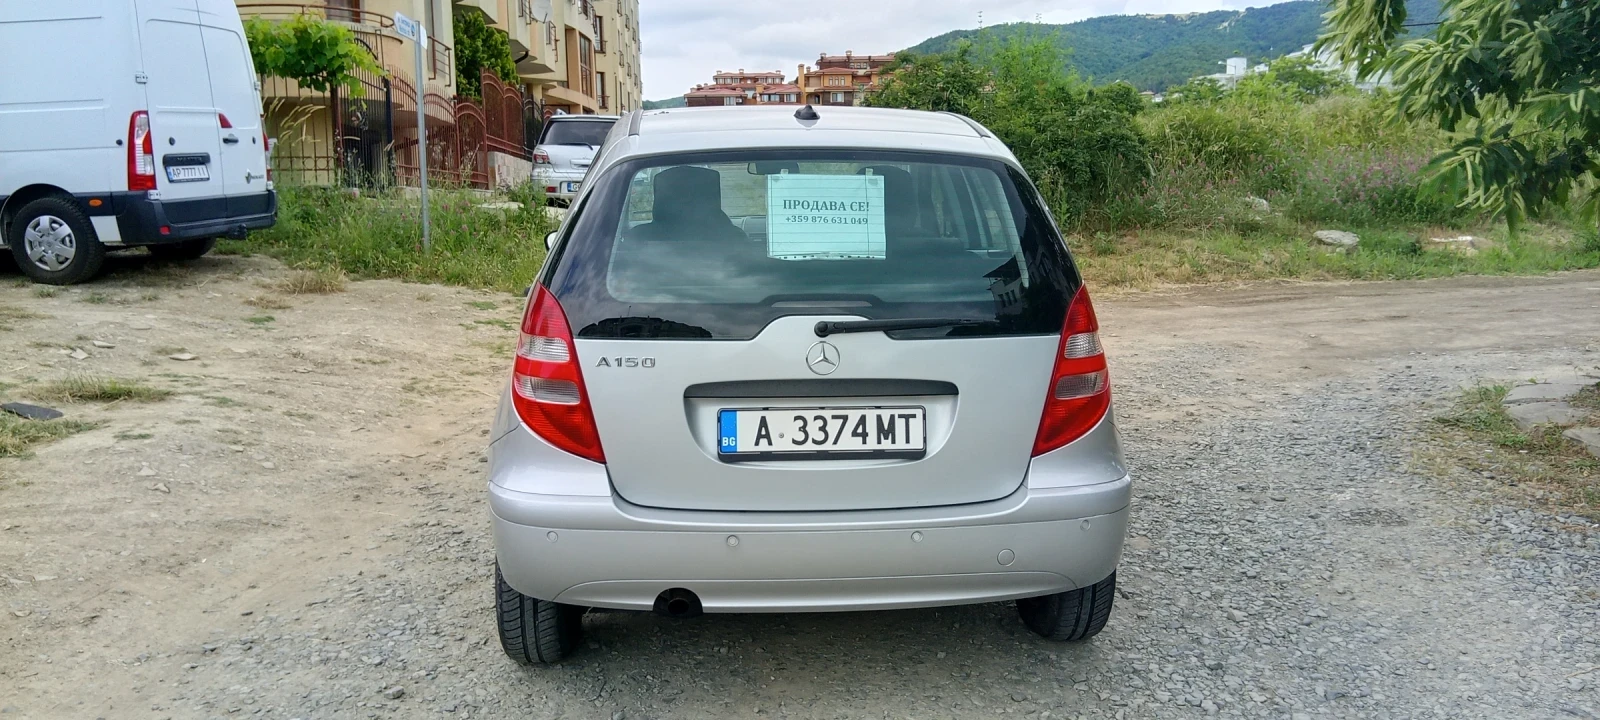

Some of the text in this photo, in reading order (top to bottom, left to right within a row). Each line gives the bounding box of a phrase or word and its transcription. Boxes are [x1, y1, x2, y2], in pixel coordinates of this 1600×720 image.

[783, 199, 870, 212] ПРОДАВА СЕ!
[785, 215, 868, 225] +359 876 631 049
[754, 413, 917, 446] A 3374 MT
[722, 437, 736, 447] BG
